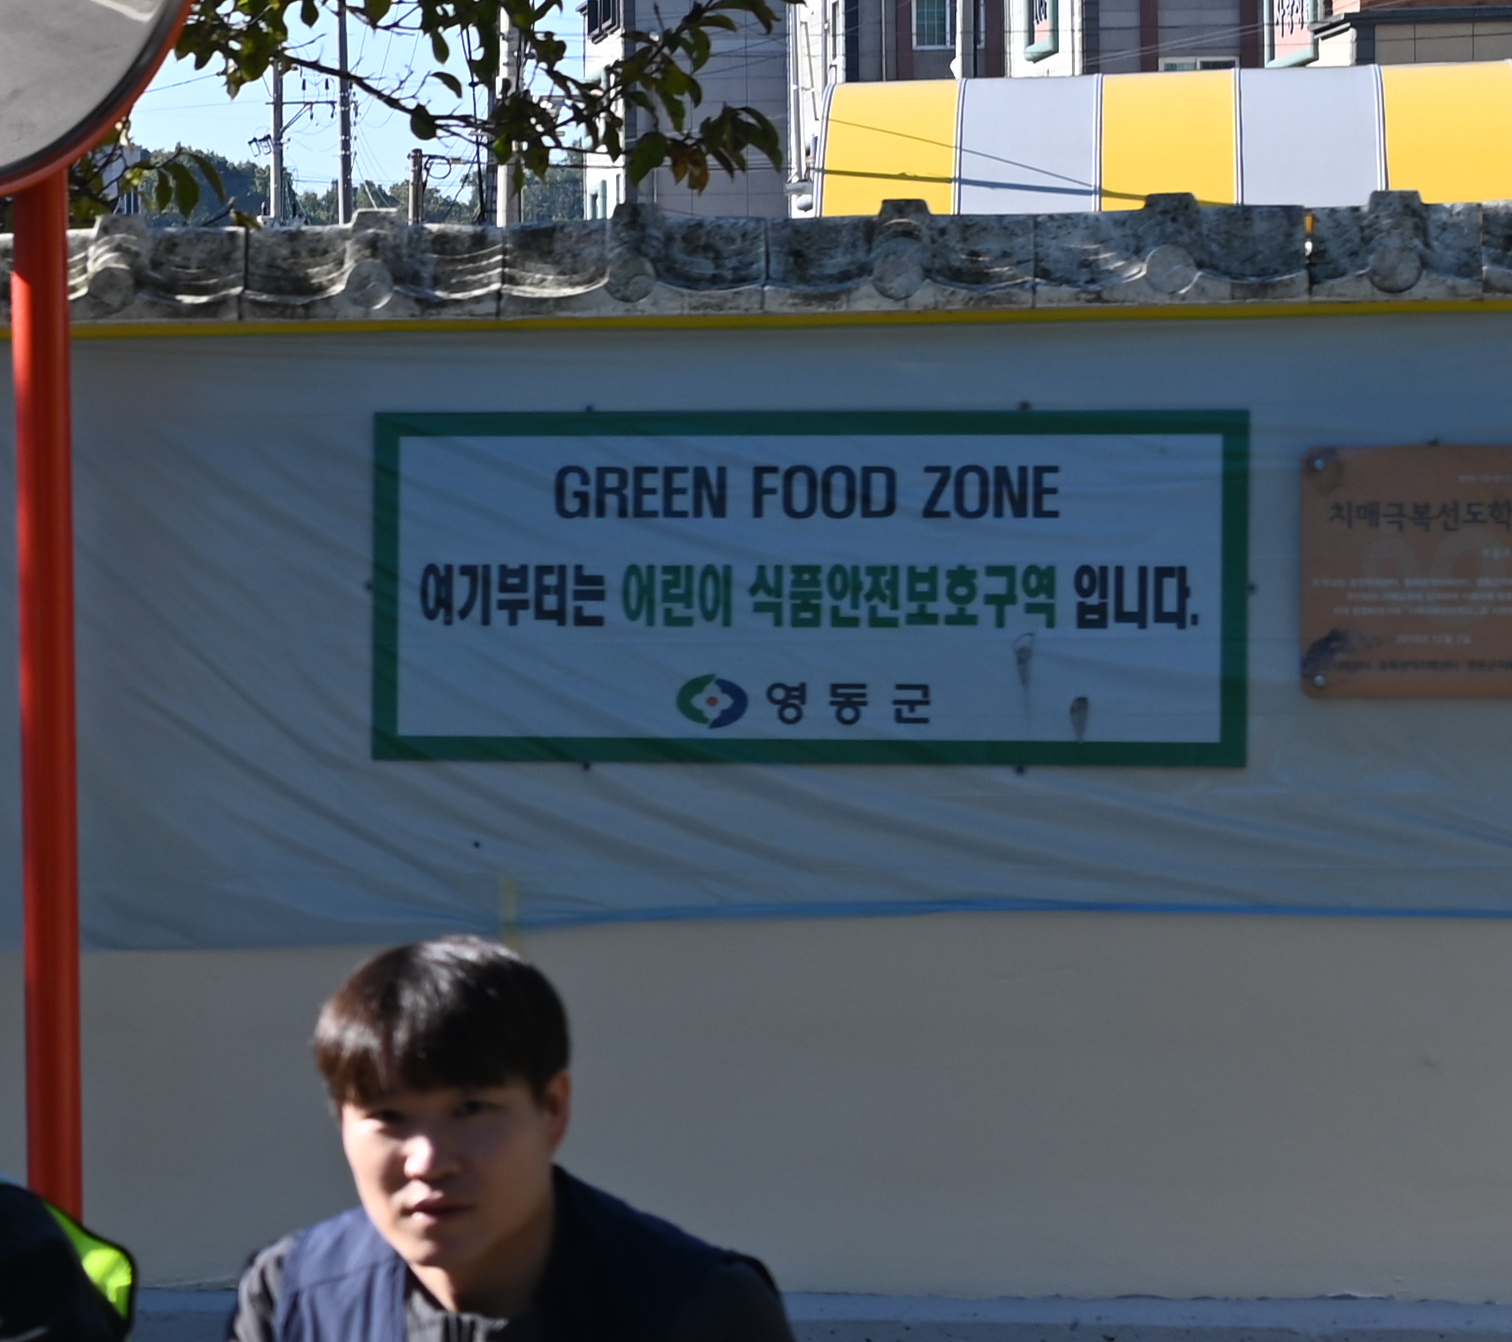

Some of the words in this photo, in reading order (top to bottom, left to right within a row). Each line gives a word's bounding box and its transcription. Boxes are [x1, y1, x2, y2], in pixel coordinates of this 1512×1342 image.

[554, 465, 727, 519] GREEN
[752, 465, 897, 519] FOOD
[922, 464, 1059, 519] ZONE
[419, 563, 606, 627] 여기부터는
[621, 563, 733, 627] 어린이
[748, 563, 1056, 629] 식품안전보호구역
[1074, 565, 1198, 630] 입니다.
[766, 682, 930, 725] 영동군
